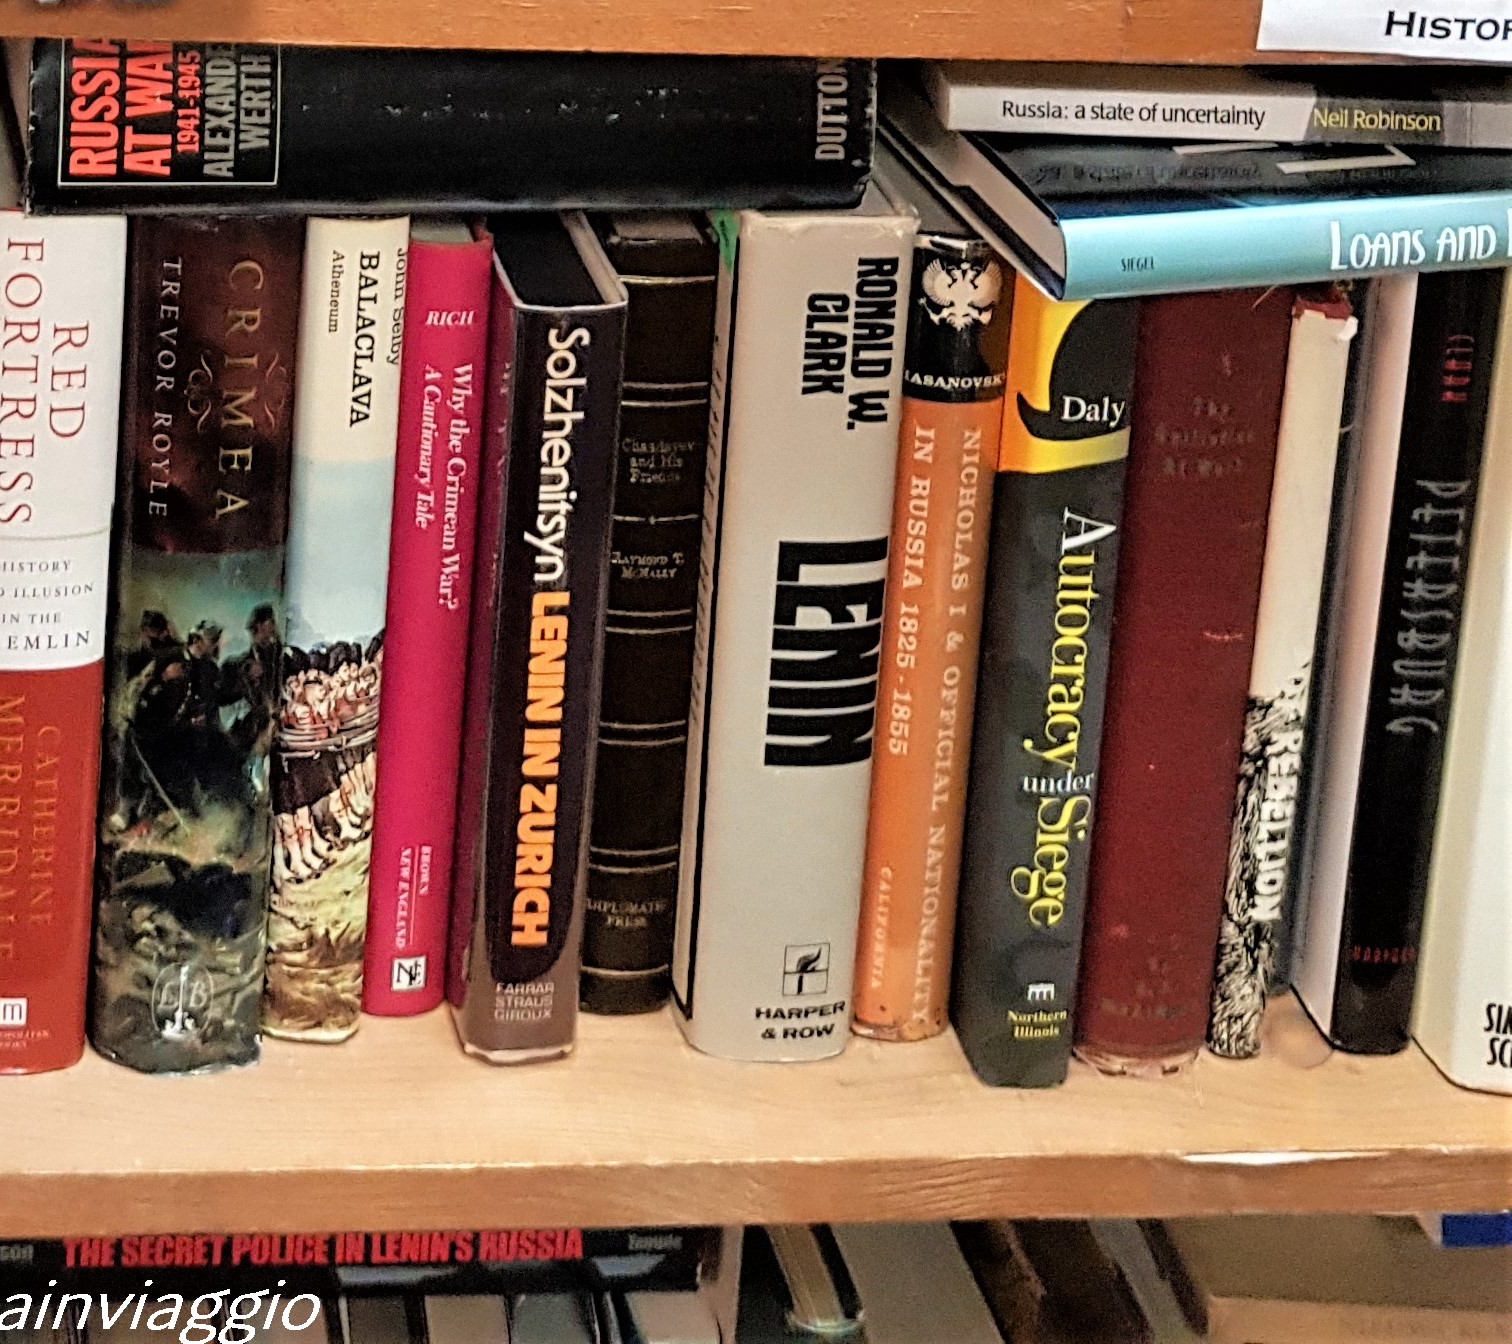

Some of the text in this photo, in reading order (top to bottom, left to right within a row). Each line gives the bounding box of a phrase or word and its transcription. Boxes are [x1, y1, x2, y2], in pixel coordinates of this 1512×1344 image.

[238, 54, 272, 150] WERTH
[1002, 100, 1266, 131] Russia: a state of uncertainty
[1313, 110, 1442, 132] Neil Robinson
[349, 250, 380, 428] BALACLAVA
[426, 311, 474, 328] RICH
[48, 320, 90, 439] RED
[215, 260, 265, 518] CRIMEA
[1061, 396, 1124, 426] Daly
[524, 325, 590, 583] Solzhenitsyn
[763, 537, 887, 766] LENIN
[510, 591, 570, 948] LENIN IN ZURICH
[64, 1230, 583, 1269] THE SECRET POLICE IN LENIN'S RUSSIA
